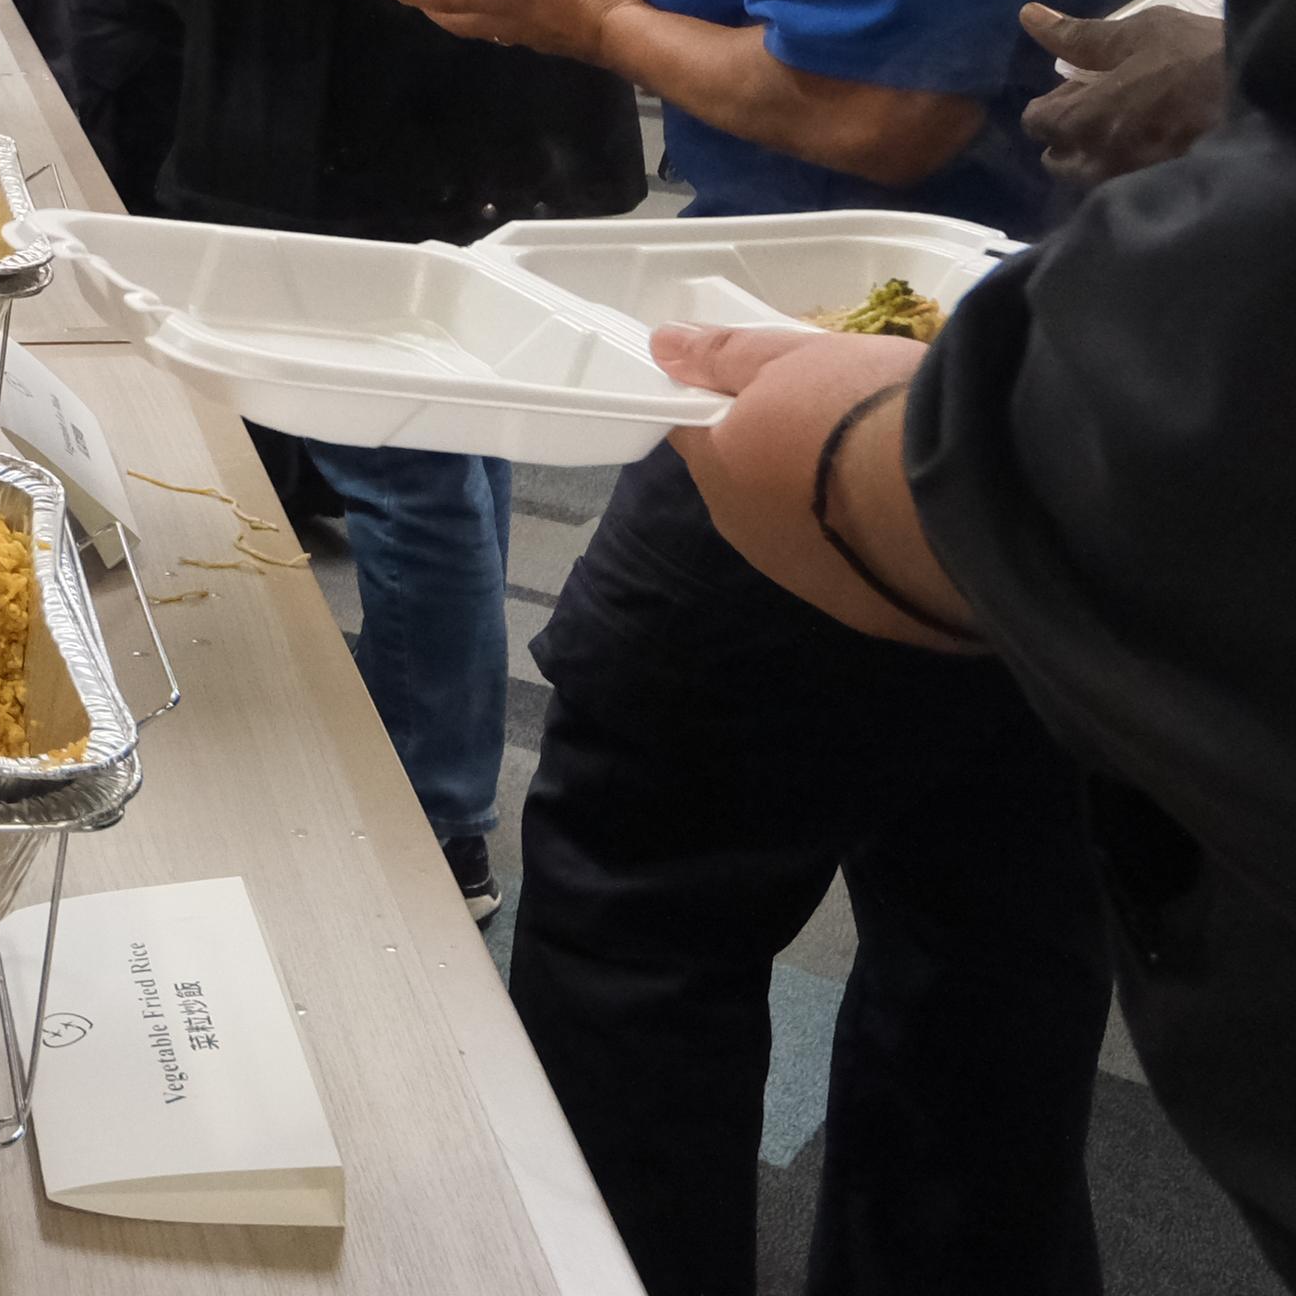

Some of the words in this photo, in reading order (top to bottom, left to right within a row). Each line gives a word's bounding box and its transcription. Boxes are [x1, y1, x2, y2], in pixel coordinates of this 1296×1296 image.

[128, 941, 152, 974] Rice
[134, 978, 164, 1019] Fried
[174, 981, 220, 1051] 菜粒炒飯
[148, 1024, 189, 1104] Vegetable
